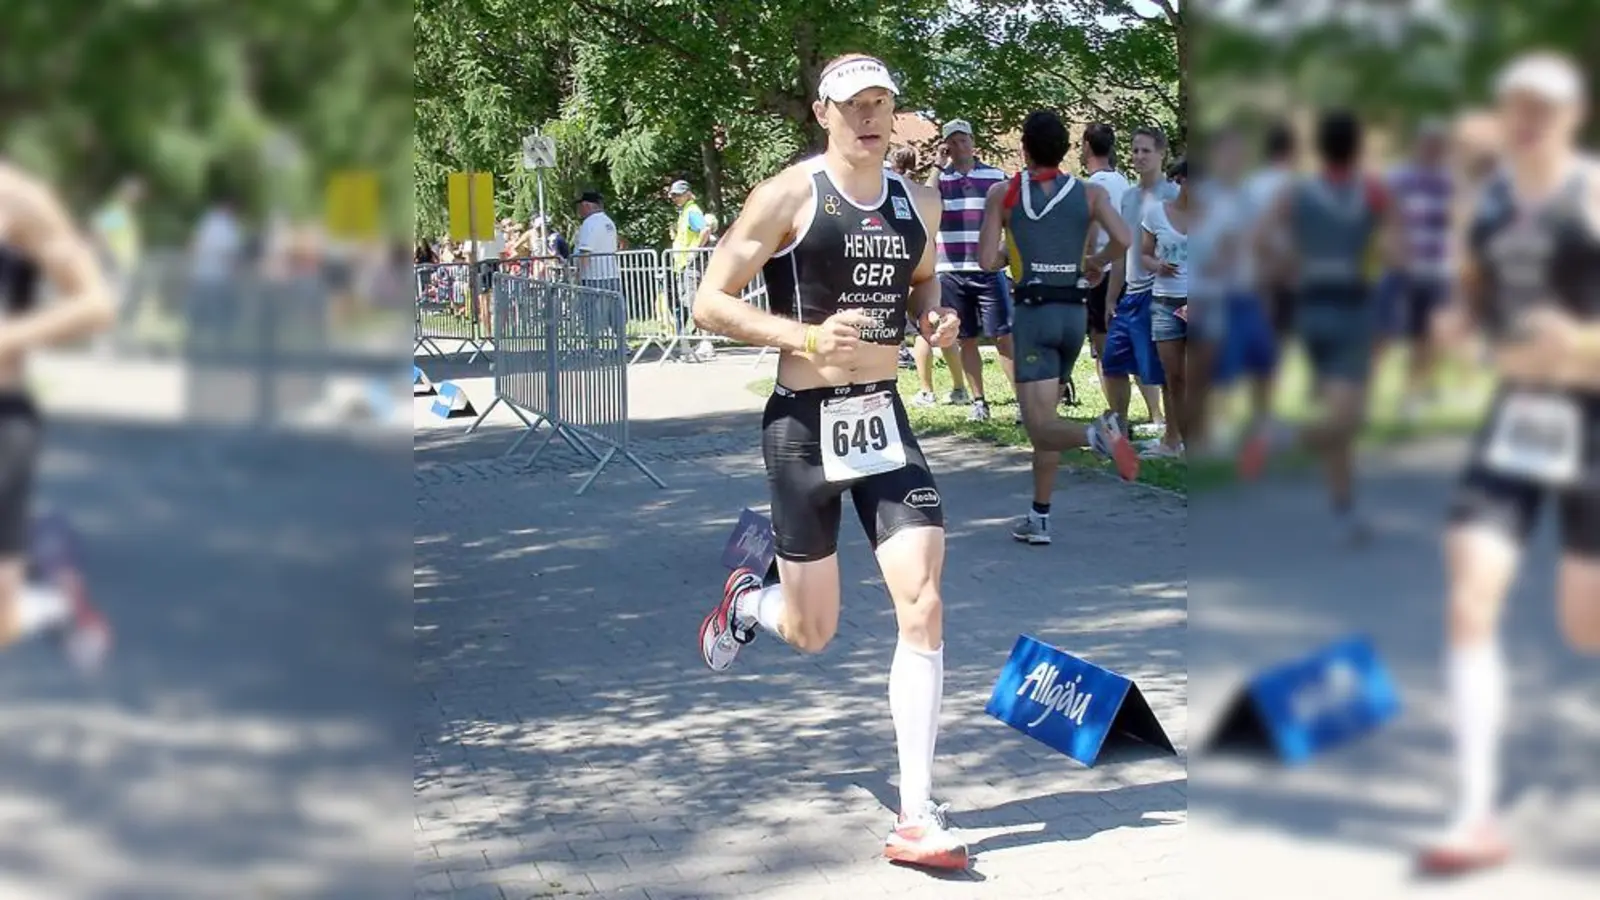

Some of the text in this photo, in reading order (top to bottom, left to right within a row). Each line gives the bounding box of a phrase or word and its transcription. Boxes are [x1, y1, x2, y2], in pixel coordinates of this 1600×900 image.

[844, 234, 910, 259] HENTZEL
[852, 263, 895, 286] GER
[833, 415, 888, 457] 649
[1016, 661, 1092, 727] Allgäu
